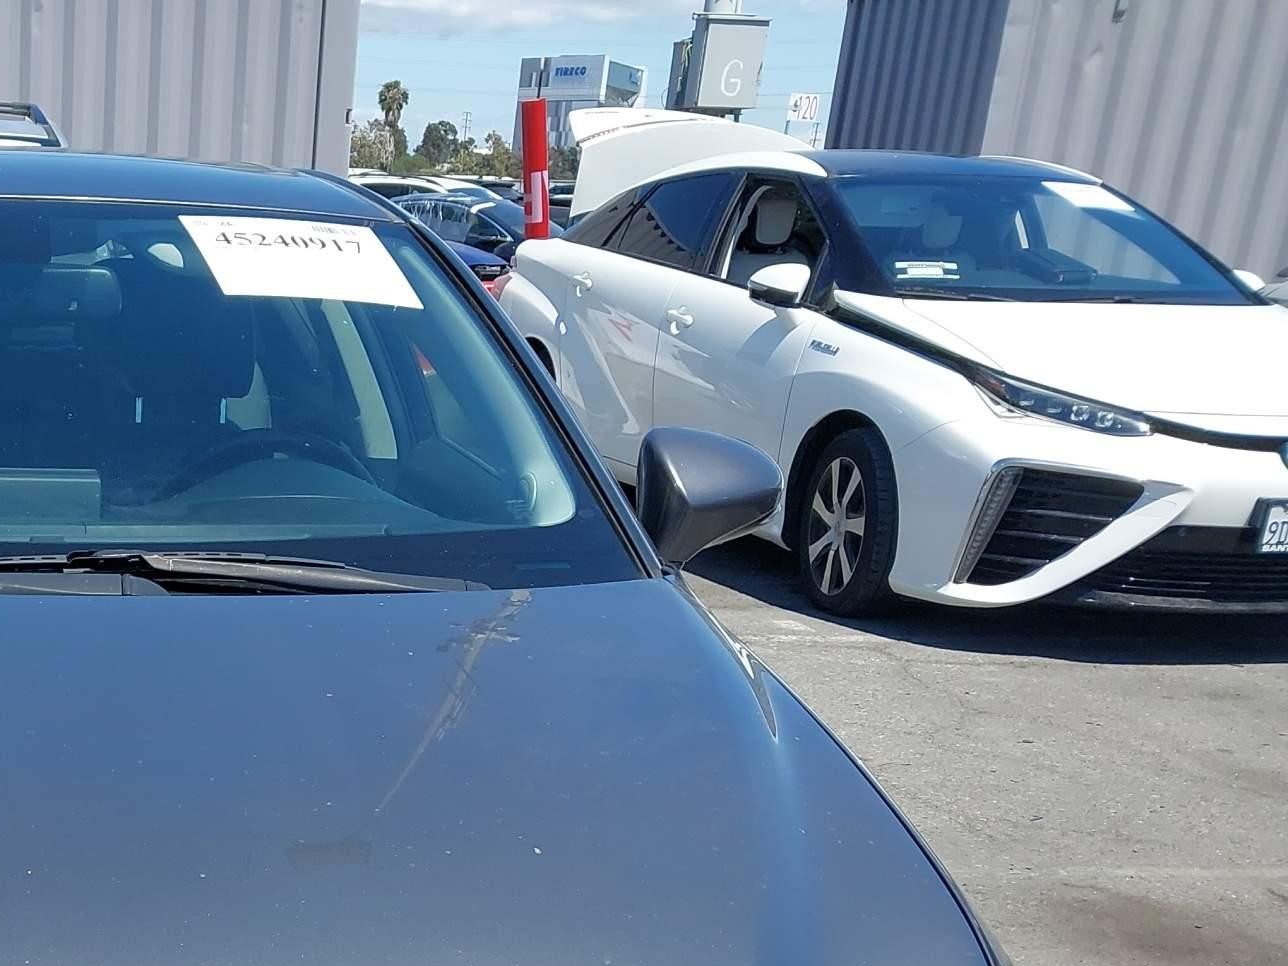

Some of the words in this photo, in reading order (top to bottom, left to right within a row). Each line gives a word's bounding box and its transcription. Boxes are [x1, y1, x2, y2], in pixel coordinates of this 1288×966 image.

[554, 66, 587, 77] TIRECO
[720, 59, 744, 97] G
[215, 230, 361, 254] 45240917
